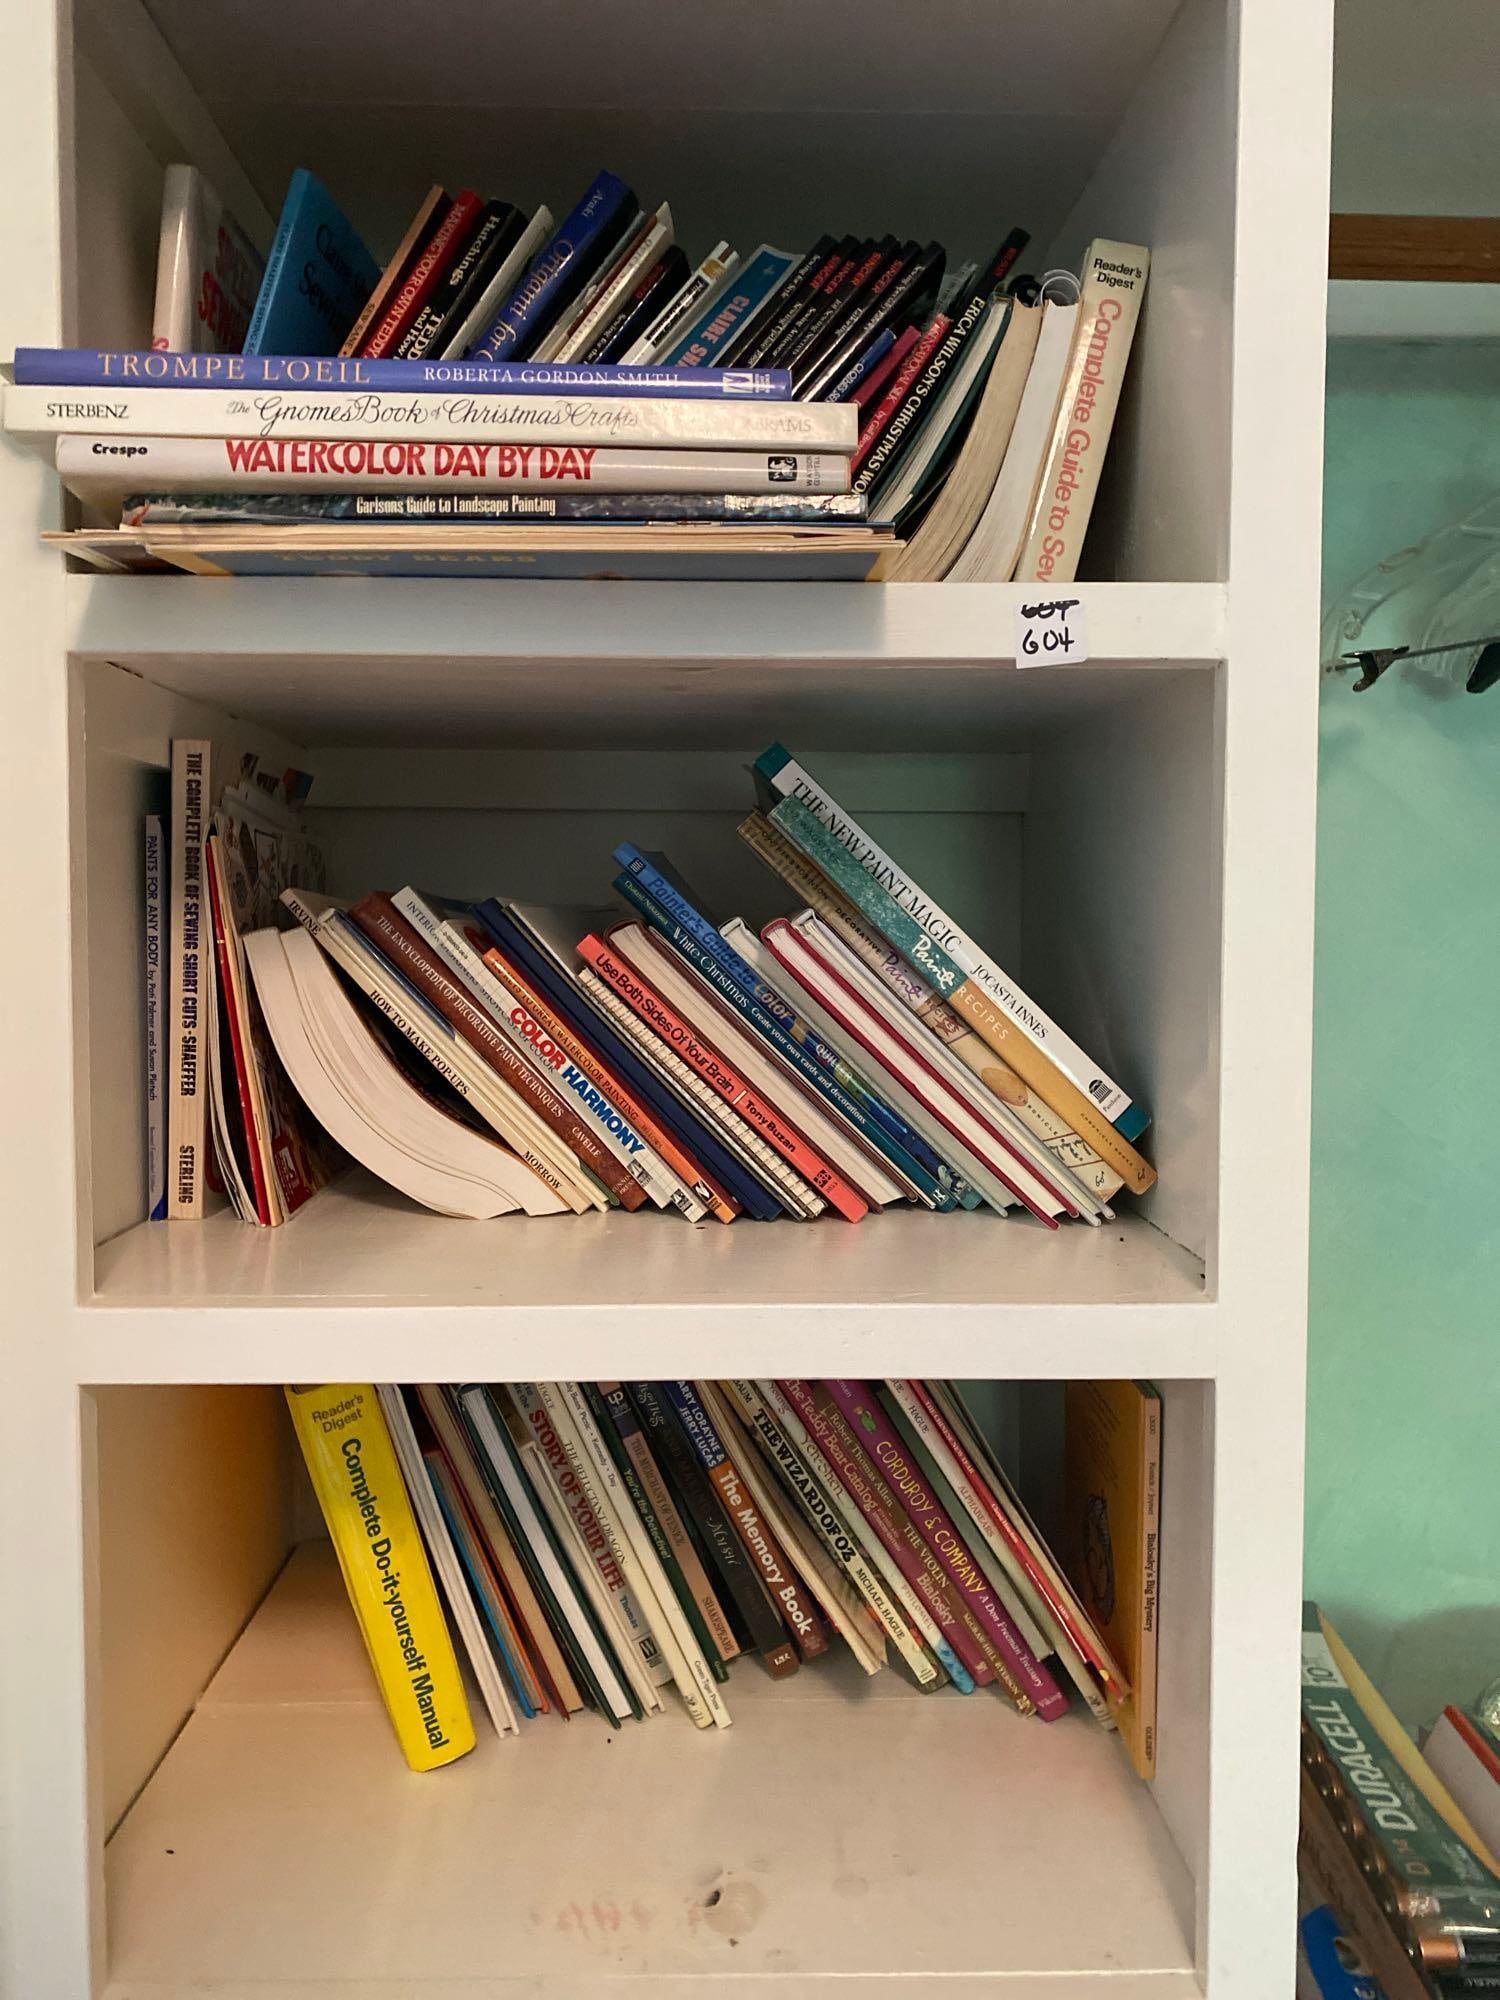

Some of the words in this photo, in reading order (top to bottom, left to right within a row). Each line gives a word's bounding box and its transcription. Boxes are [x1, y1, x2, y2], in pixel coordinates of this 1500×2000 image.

[427, 200, 465, 254] MAKING
[407, 250, 438, 289] YOUR
[446, 210, 500, 290] Hutchings
[807, 251, 842, 291] SINGER
[1094, 258, 1142, 279] Reader's
[506, 233, 578, 323] Origami
[1097, 271, 1134, 290] Digest
[390, 283, 418, 320] OWN
[951, 294, 986, 338] ERICA
[484, 318, 520, 355] for
[897, 328, 941, 387] SENSATIONAL
[96, 353, 245, 379] TROMPE
[262, 360, 371, 384] L'OEIL
[424, 364, 513, 384] ROBERTA
[520, 368, 608, 386] GORDON
[615, 371, 677, 386] SMITH
[914, 331, 963, 398] WILSON'S
[1069, 295, 1124, 426] Complete
[46, 402, 129, 419] STERBENZ
[886, 383, 905, 405] SILK
[91, 442, 148, 458] Crespo
[865, 392, 924, 473] CHRISTMAS
[223, 436, 426, 478] WATERCOLOR
[433, 442, 491, 478] DAY
[497, 444, 531, 479] BY
[538, 446, 595, 481] DAY
[1054, 426, 1093, 497] Guide
[356, 495, 403, 513] Carlsons
[406, 495, 435, 514] Guide
[438, 496, 451, 513] to
[453, 495, 508, 516] Landscape
[511, 494, 556, 516] Painting
[1046, 503, 1071, 532] to
[1022, 626, 1075, 655] 604
[185, 753, 203, 775] THE
[184, 779, 202, 842] COMPLETE
[146, 834, 159, 871] PANTS
[183, 846, 201, 880] BOOK
[147, 876, 159, 900] FOR
[184, 885, 200, 899] OF
[785, 775, 829, 819] THE
[819, 811, 866, 857] NEW
[856, 847, 913, 903] PAINT
[902, 893, 965, 954] MAGIC
[968, 960, 1021, 1012] JOCASTA
[1013, 1003, 1051, 1040] INNES
[147, 904, 159, 931] ANY
[182, 902, 199, 949] SEWING
[287, 897, 321, 937] IRVINE
[834, 905, 883, 956] DECORATIVE
[147, 934, 159, 966] BODY
[905, 931, 961, 992] Paint
[147, 969, 156, 980] by
[147, 982, 157, 998] Pati
[181, 953, 198, 994] SHORT
[148, 1000, 157, 1027] Palmer
[182, 997, 197, 1029] CUTS
[593, 952, 623, 982] Use
[614, 973, 647, 1005] Both
[639, 997, 676, 1033] Sides
[667, 1025, 689, 1046] Of
[681, 1038, 711, 1068] Your
[704, 1060, 738, 1094] Brain
[668, 925, 703, 960] White
[695, 952, 754, 1009] Christmas
[748, 1005, 775, 1031] Create
[769, 1026, 789, 1047] your
[785, 1042, 802, 1059] own
[799, 1055, 821, 1076] cards
[816, 1072, 834, 1089] and
[828, 1084, 870, 1125] decorations
[954, 984, 1011, 1041] RECIPES
[148, 1029, 157, 1046] and
[369, 990, 393, 1015] HOW
[389, 1011, 407, 1030] TO
[403, 1025, 435, 1059] MAKE
[430, 1053, 471, 1097] POP-UPS
[375, 914, 395, 935] THE
[390, 931, 446, 992] ENCYCLOPEDIA
[442, 986, 458, 1003] OF
[451, 996, 500, 1049] DECORATIVE
[494, 1042, 522, 1071] PAINT
[515, 1065, 565, 1119] TECHNIQUES
[569, 1124, 601, 1158] CAVELLE
[148, 1048, 157, 1071] Susan
[180, 1035, 196, 1095] SHAEFFER
[506, 1004, 570, 1071] COLOR
[558, 1063, 649, 1159] HARMONY
[531, 1001, 558, 1031] GREAT
[555, 1027, 606, 1083] WATERCOLOR
[600, 1078, 639, 1122] PAINTING
[741, 1097, 770, 1126] Tony
[764, 1120, 797, 1153] Buzan
[177, 1144, 195, 1203] STERLING
[521, 1148, 562, 1191] MORROW
[312, 1394, 363, 1422] Reader's
[322, 1408, 362, 1433] Digest
[906, 1404, 931, 1435] HAGUE
[526, 1406, 570, 1471] STORY
[677, 1404, 700, 1434] JERRY
[694, 1435, 717, 1468] LUCAS
[784, 1375, 808, 1402] The
[796, 1396, 832, 1439] Teddy
[821, 1433, 851, 1467] Bear
[838, 1461, 880, 1513] Catalog
[798, 1432, 844, 1498] Yeh-Shen
[829, 1411, 855, 1445] Robert
[849, 1443, 879, 1482] Thomas
[873, 1479, 897, 1508] Allen
[872, 1437, 934, 1516] CORDUROY
[555, 1469, 583, 1500] OF
[562, 1439, 580, 1462] THE
[571, 1463, 610, 1522] RELUCTANT
[600, 1521, 631, 1566] DRAGON
[621, 1466, 645, 1499] You're
[715, 1468, 749, 1508] The
[751, 1407, 783, 1448] THE
[773, 1442, 827, 1517] WIZARD
[817, 1512, 841, 1539] OF
[831, 1534, 857, 1563] OZ
[568, 1495, 609, 1554] YOUR
[636, 1498, 650, 1514] the
[922, 1512, 942, 1531] &
[956, 1484, 995, 1539] ALPHABEARS
[641, 1513, 673, 1561] Detective!
[731, 1505, 790, 1589] Memory
[901, 1521, 923, 1550] THE
[917, 1546, 949, 1590] VIOLIN
[1143, 1533, 1156, 1577] Bialosky's
[594, 1549, 628, 1593] LIFE
[930, 1527, 987, 1598] COMPANY
[337, 1437, 386, 1539] Complete
[367, 1536, 427, 1675] Do-it-yourself
[410, 1672, 450, 1750] Manual
[855, 1567, 886, 1610] MICHAEL
[881, 1607, 906, 1640] HAGUE
[914, 1572, 956, 1628] Bialosky
[1144, 1579, 1154, 1594] Big
[617, 1594, 641, 1630] Thomas
[698, 1595, 739, 1654] SHAKESPEARE
[777, 1584, 816, 1636] Book
[1142, 1596, 1154, 1632] Mystery
[978, 1591, 990, 1604] A
[984, 1601, 1002, 1622] Don
[996, 1619, 1023, 1654] Freeman
[1016, 1653, 1045, 1689] Treasury
[1307, 1666, 1338, 1686] 10
[1305, 1699, 1417, 1832] DURACELL
